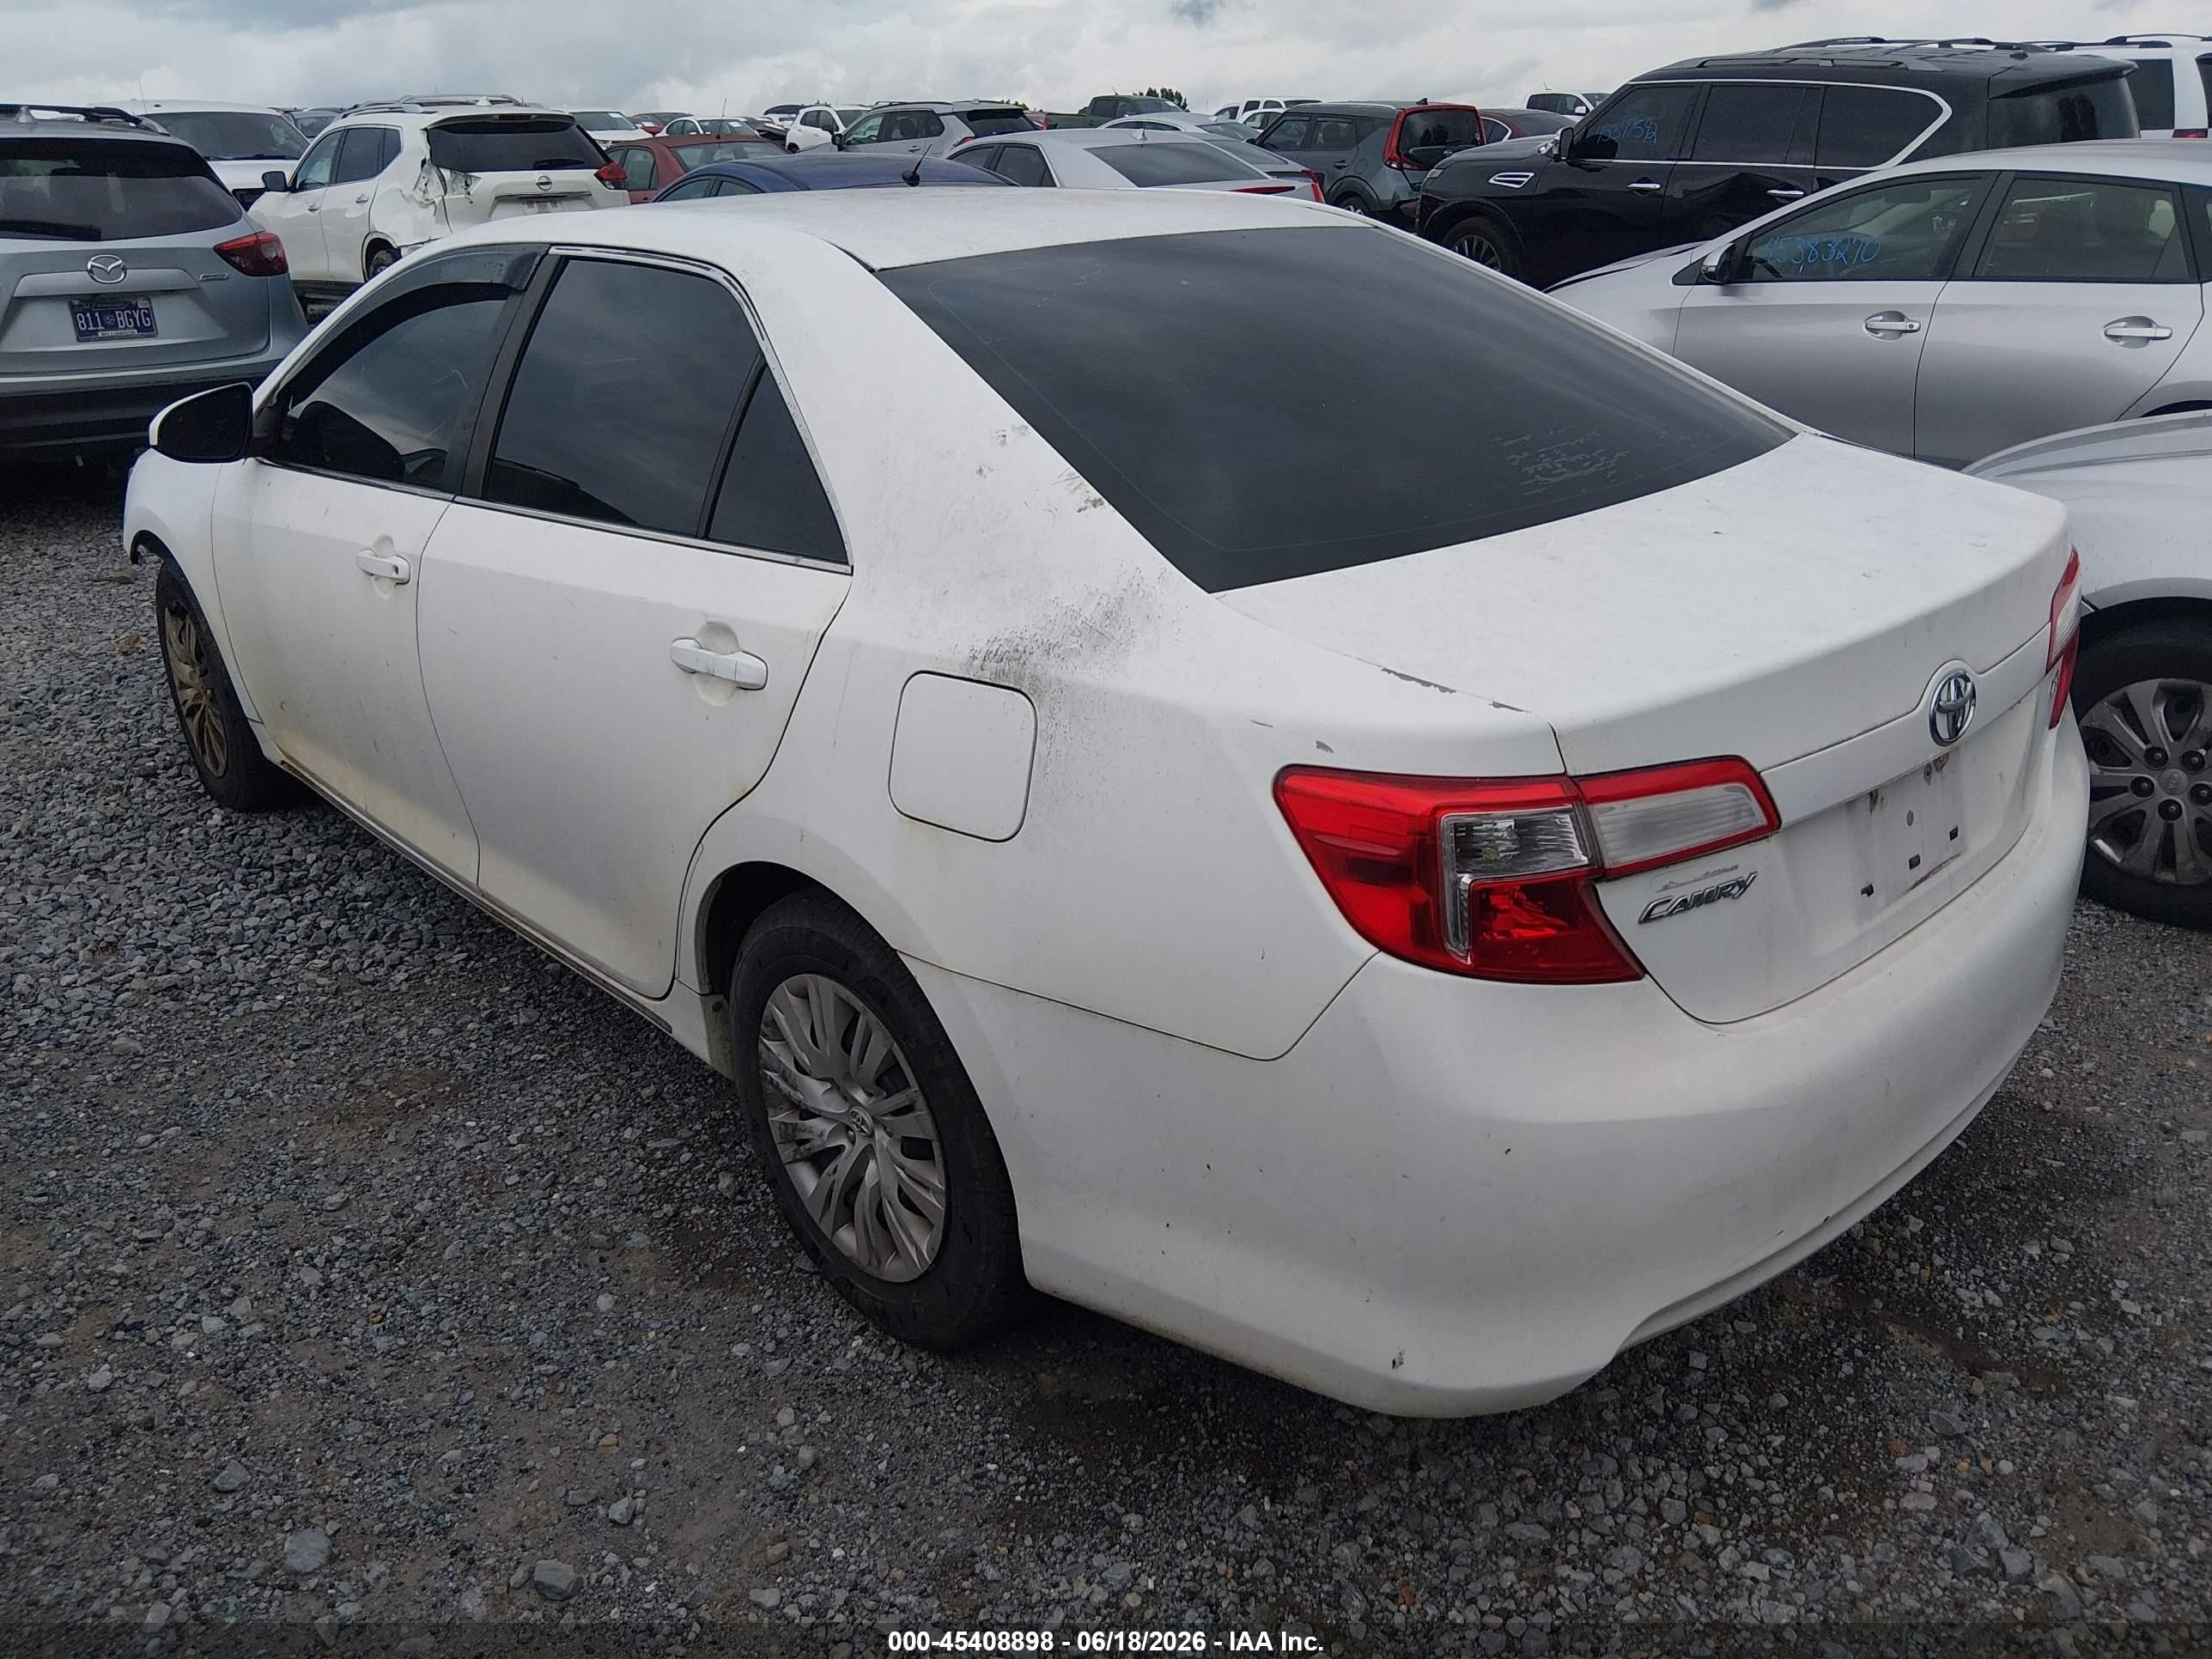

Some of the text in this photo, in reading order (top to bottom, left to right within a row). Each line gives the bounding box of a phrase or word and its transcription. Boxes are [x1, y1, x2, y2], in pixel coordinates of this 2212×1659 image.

[76, 309, 151, 331] 811 BGYG
[1638, 870, 1759, 925] CAMRY
